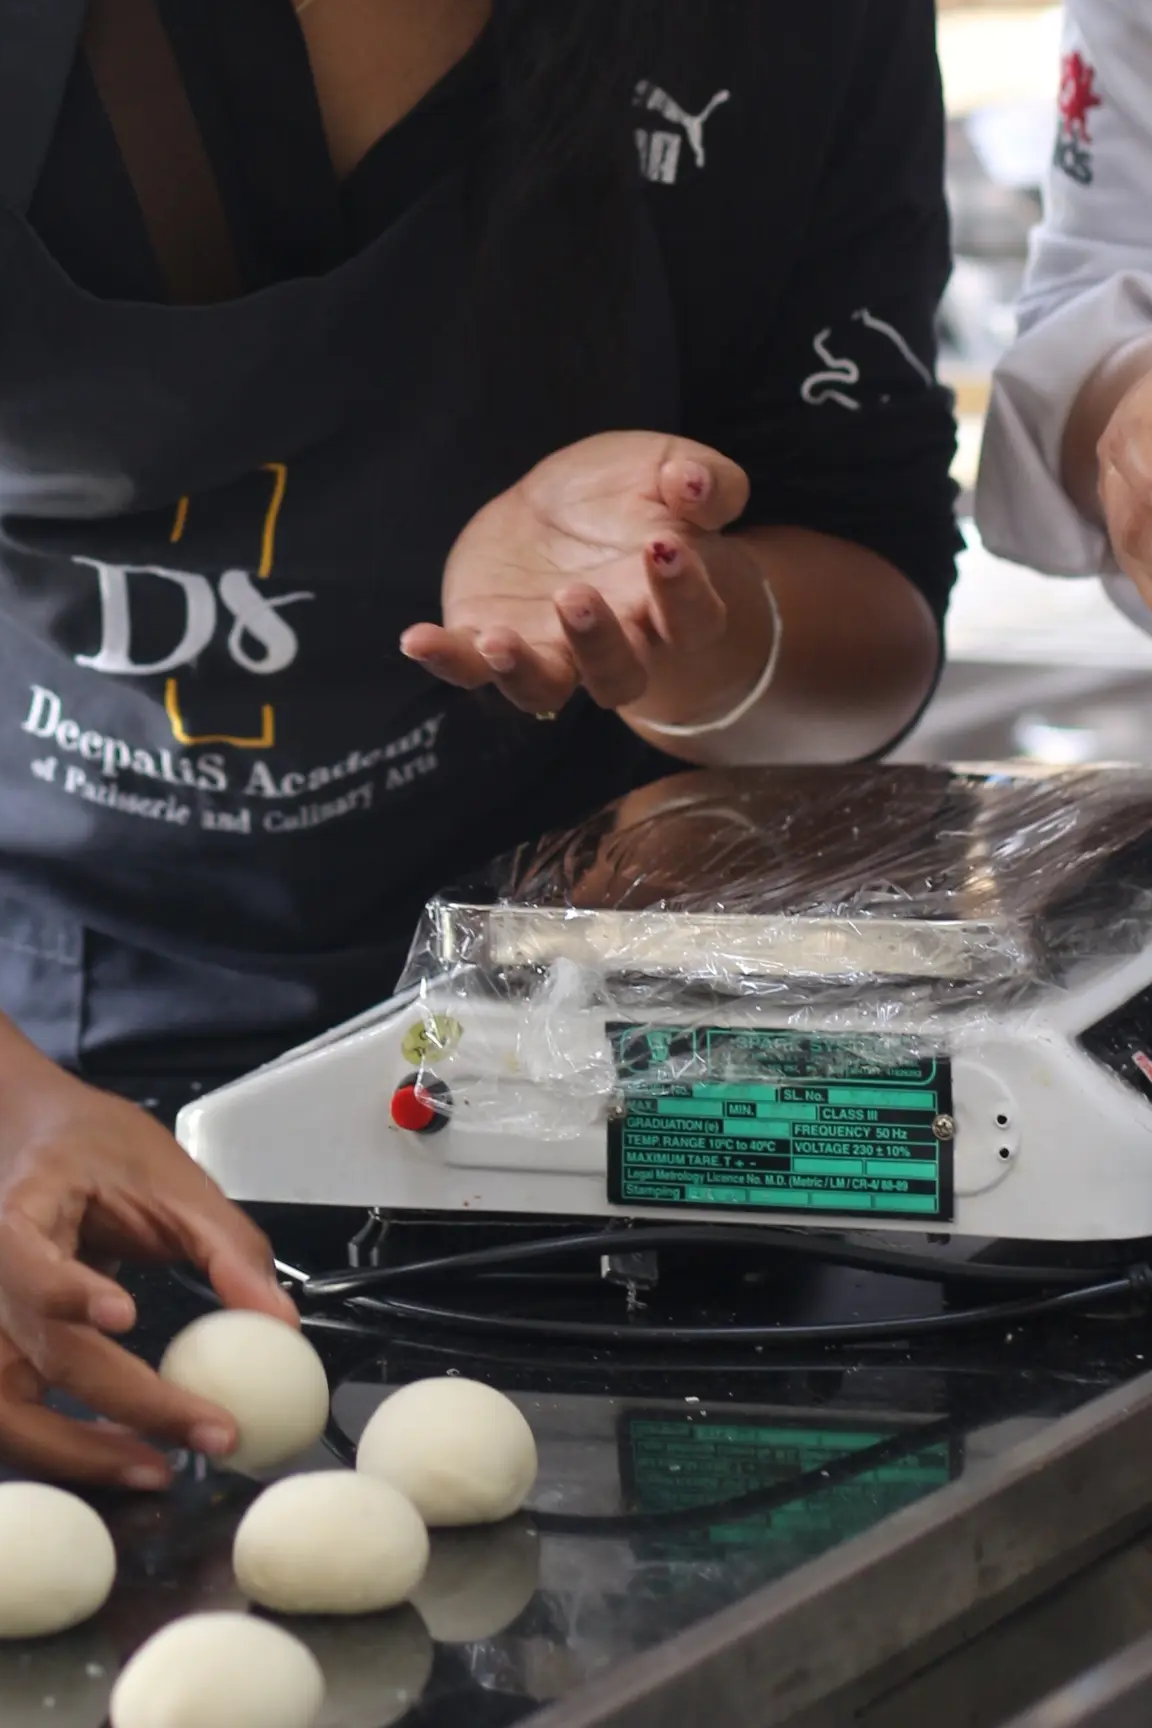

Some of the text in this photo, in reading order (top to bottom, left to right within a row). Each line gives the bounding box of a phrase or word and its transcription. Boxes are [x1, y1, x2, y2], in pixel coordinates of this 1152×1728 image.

[805, 1090, 826, 1102] No.
[728, 1103, 755, 1116] MIN.
[822, 1108, 879, 1122] CLASS III
[626, 1116, 703, 1132] GRADUATION
[794, 1124, 908, 1140] FREQUENCY 50 Hz
[662, 1135, 706, 1149] RANGE
[735, 1139, 748, 1151] to
[794, 1141, 851, 1155] VOLTAGE
[852, 1144, 874, 1156] 230
[886, 1145, 912, 1158] 10%
[626, 1151, 686, 1165] MAXIMUM
[627, 1168, 654, 1182] Legal
[655, 1169, 705, 1185] Metrology
[706, 1172, 745, 1184] Licence
[746, 1173, 764, 1184] No.
[764, 1175, 787, 1186] M.D.
[788, 1175, 824, 1189] (Metric
[626, 1184, 681, 1201] Stamping
